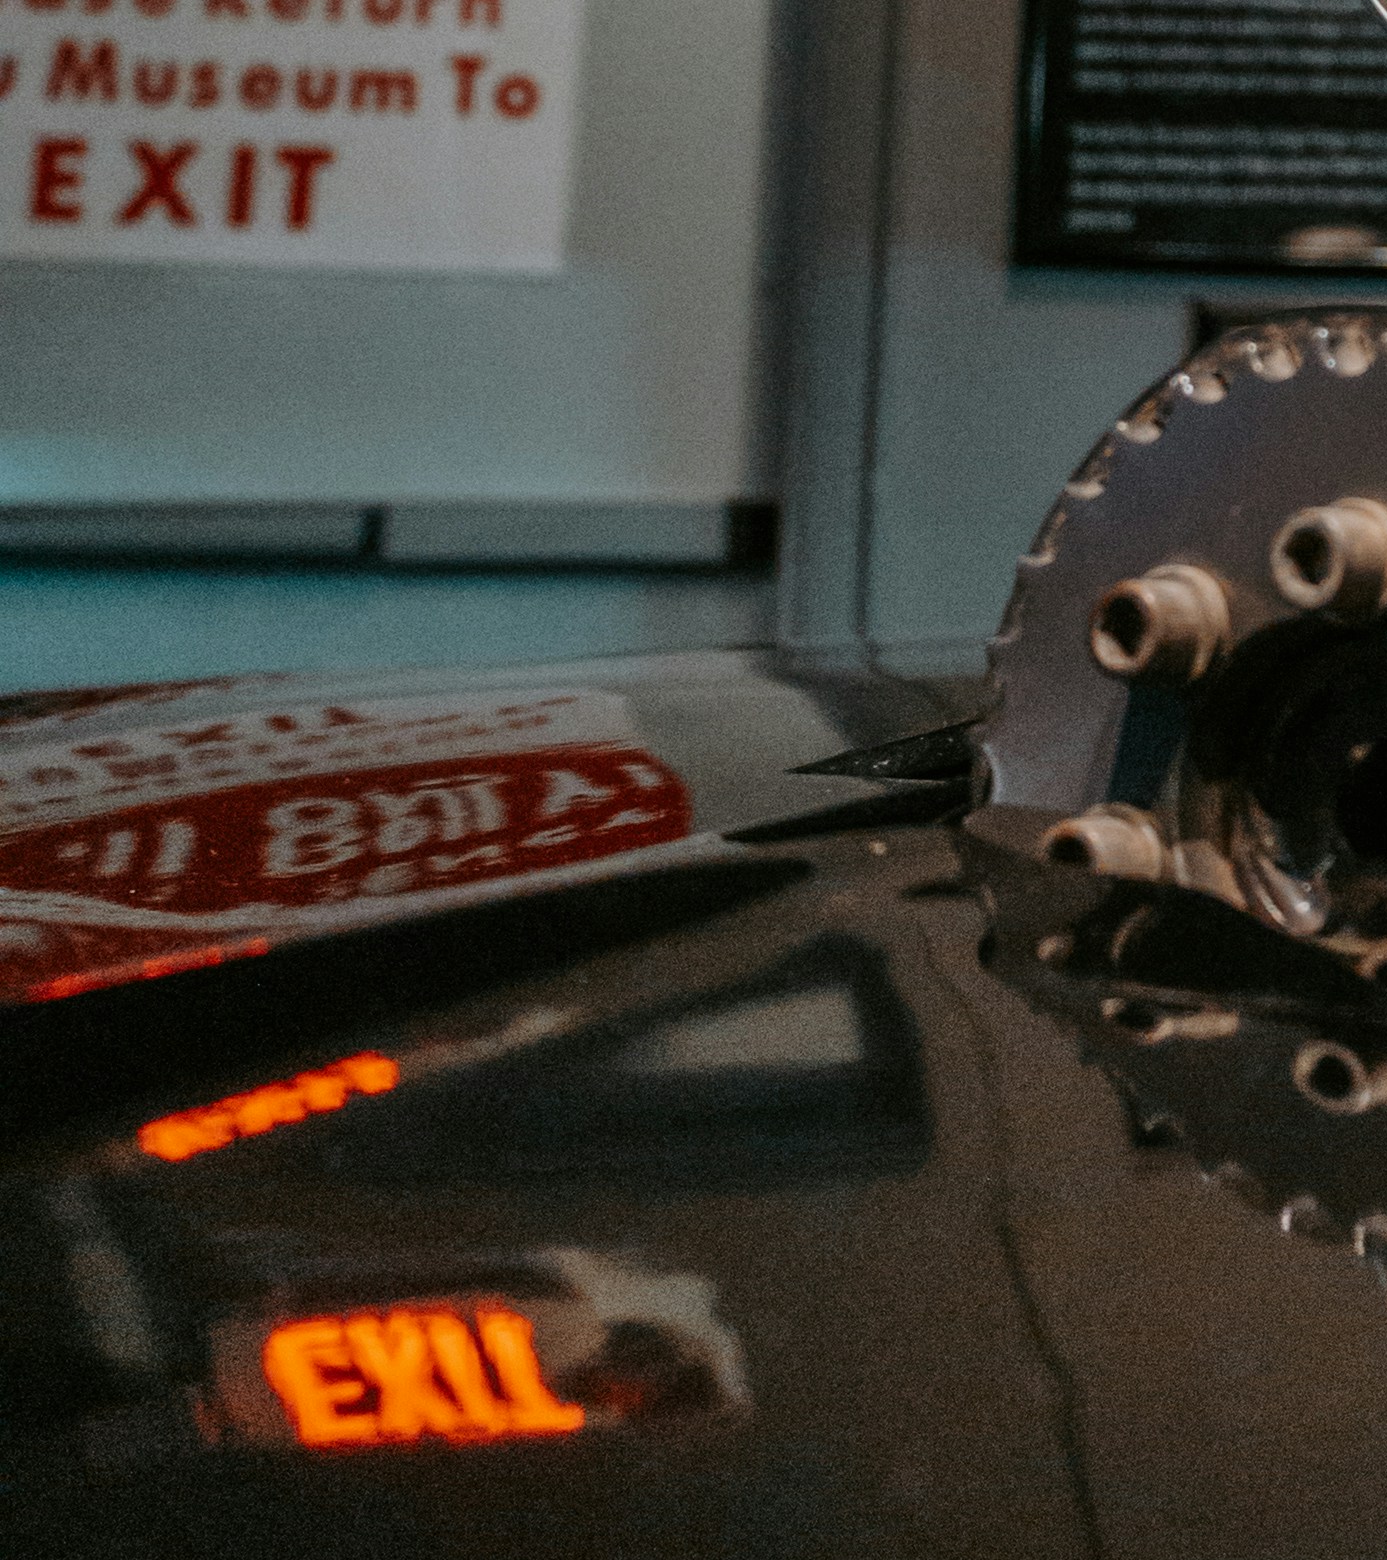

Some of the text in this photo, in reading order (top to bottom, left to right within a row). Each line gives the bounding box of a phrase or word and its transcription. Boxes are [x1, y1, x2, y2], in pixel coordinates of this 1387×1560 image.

[46, 38, 420, 114] Museum
[449, 53, 542, 121] To
[27, 135, 337, 232] EXIT
